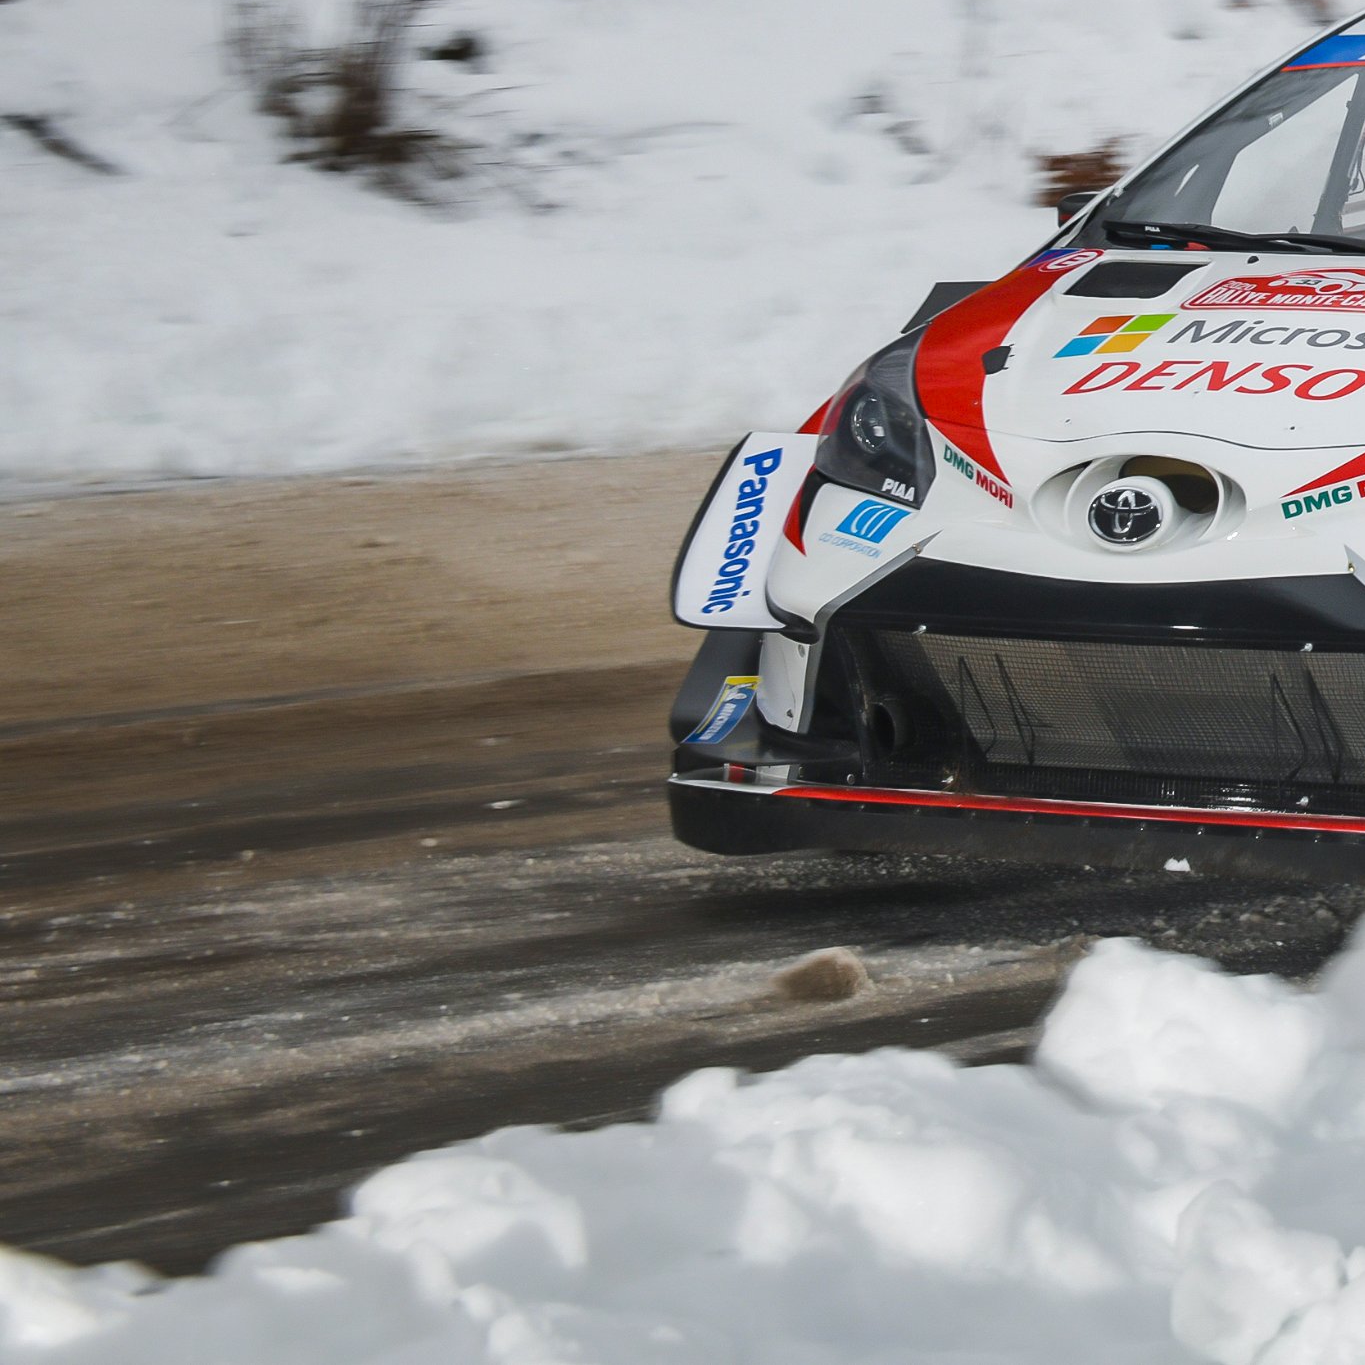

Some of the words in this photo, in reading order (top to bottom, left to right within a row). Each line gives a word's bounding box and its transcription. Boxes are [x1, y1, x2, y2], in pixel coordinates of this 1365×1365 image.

[1200, 287, 1268, 305] RALLYE
[1296, 278, 1321, 286] 33
[881, 477, 916, 503] PIAA
[943, 444, 974, 481] DMG
[974, 469, 1014, 510] MORI
[1280, 485, 1353, 520] DMG
[700, 447, 784, 616] Panasonic
